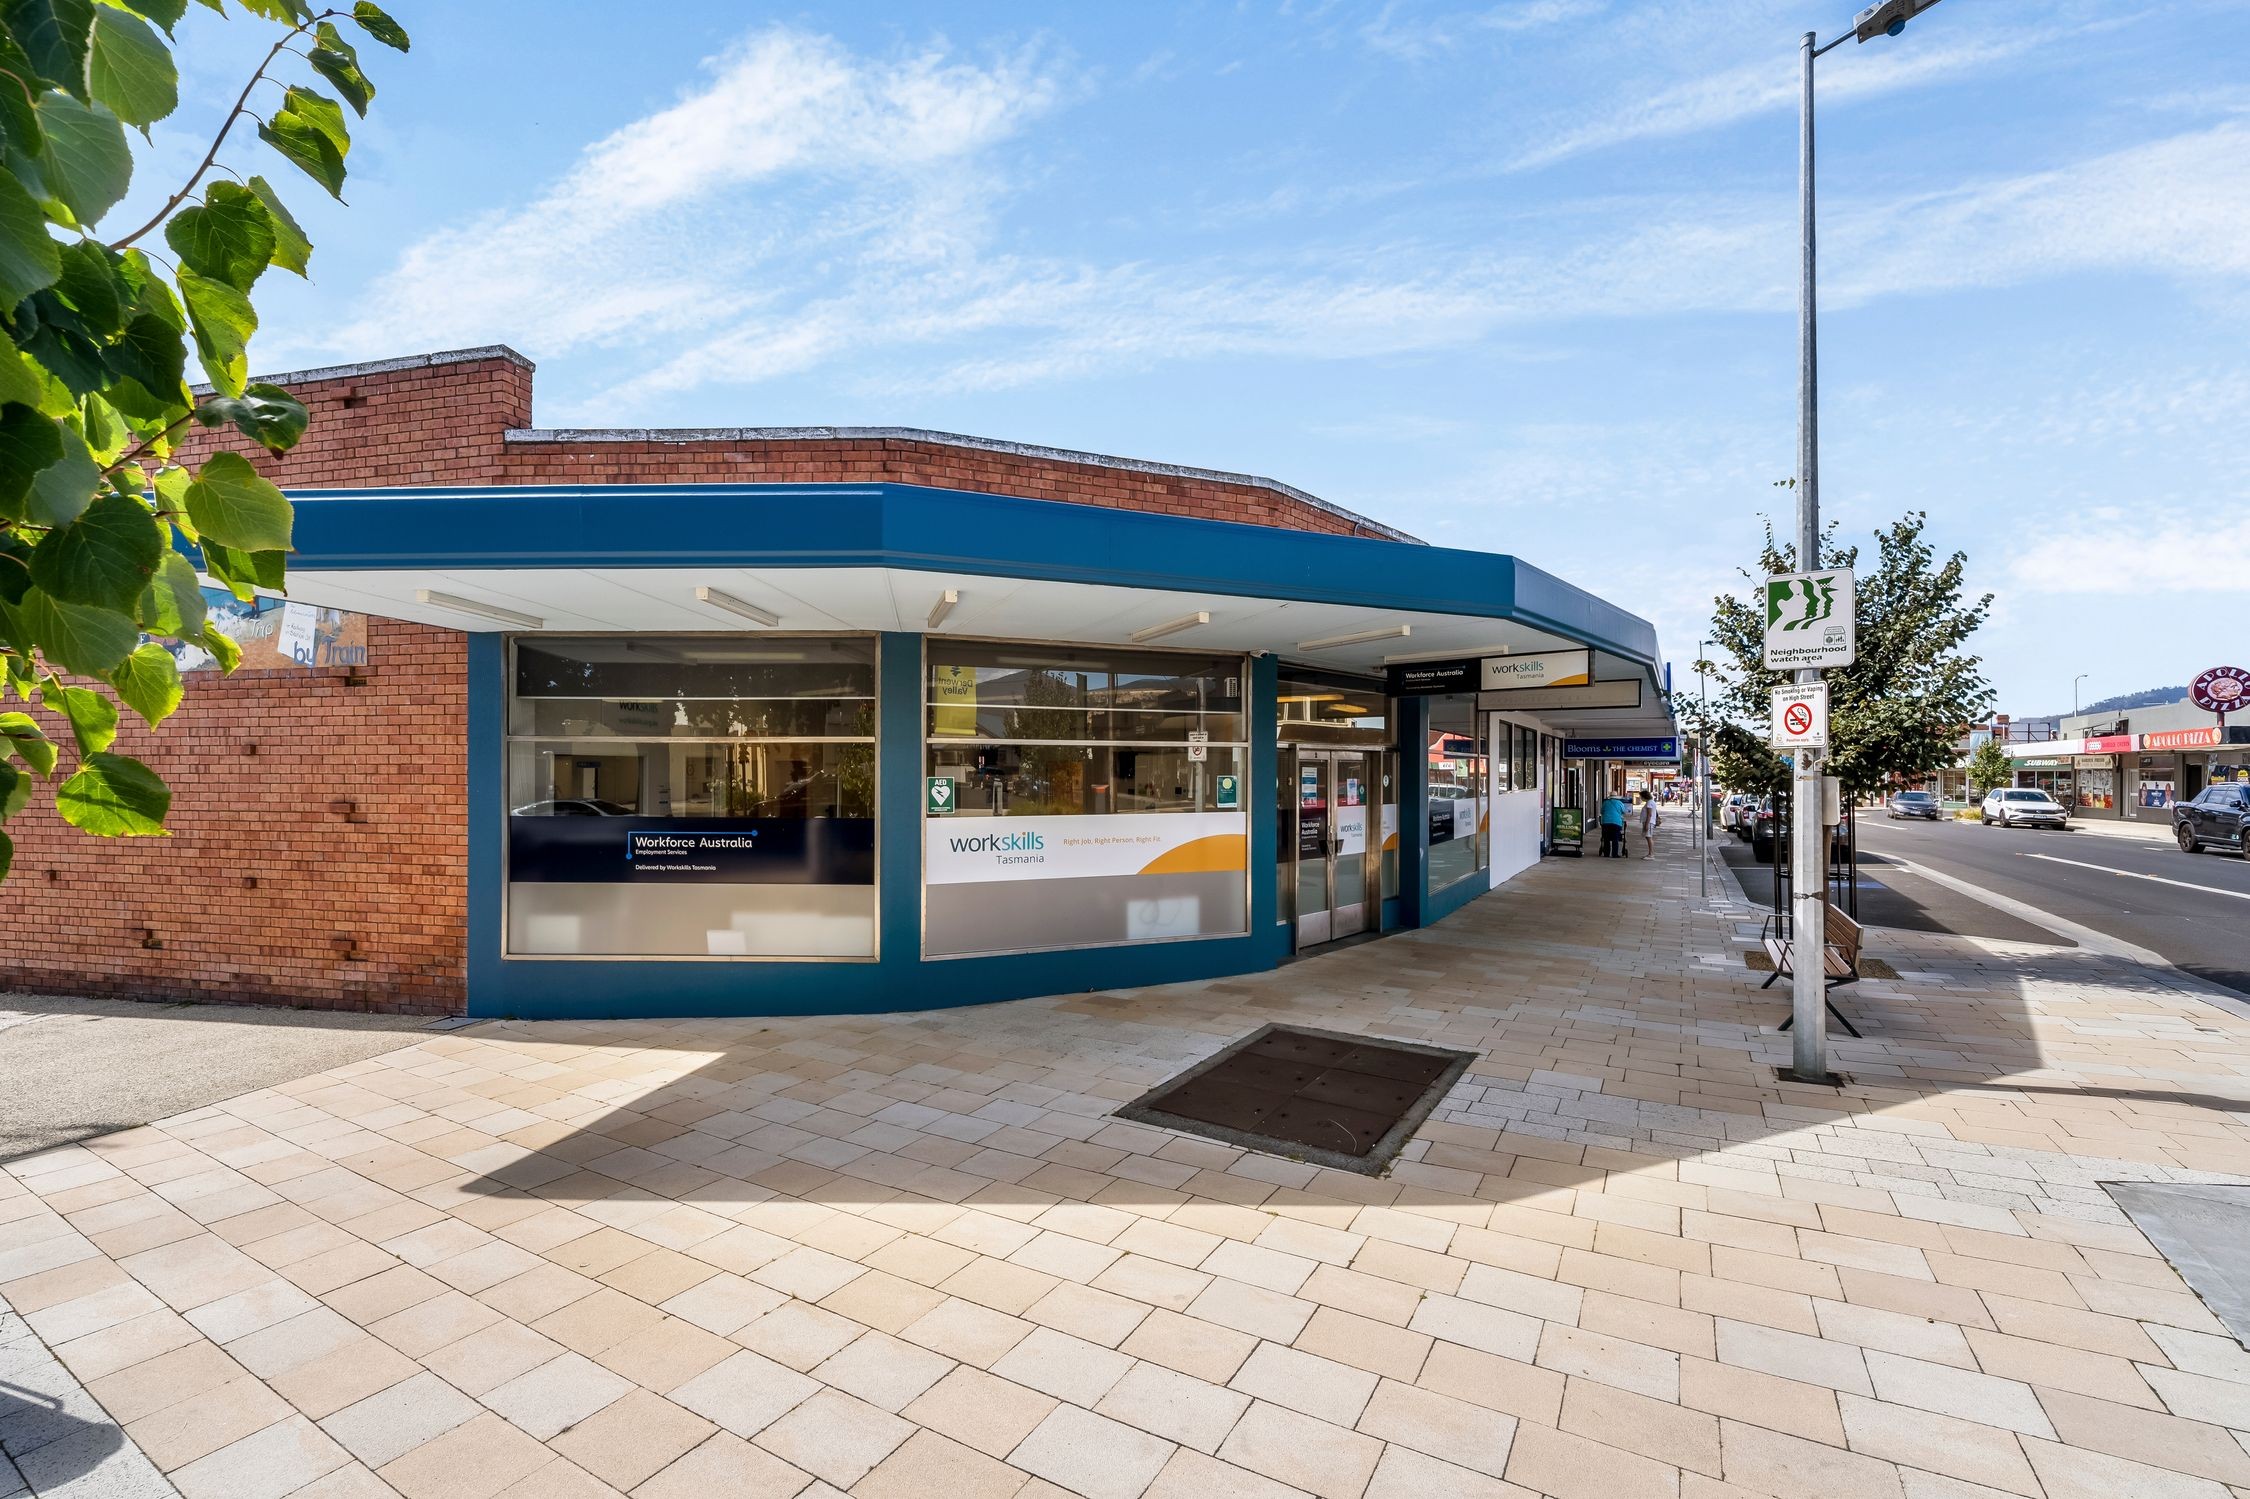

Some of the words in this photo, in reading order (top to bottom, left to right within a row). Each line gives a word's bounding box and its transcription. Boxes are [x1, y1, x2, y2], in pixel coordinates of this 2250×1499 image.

[293, 641, 316, 667] by
[322, 635, 366, 665] Train
[1770, 645, 1847, 656] Neighbourhood
[1770, 655, 1800, 663] watch
[1492, 661, 1545, 674] workskills
[1405, 671, 1435, 679] Workforce
[1436, 669, 1464, 677] Australia
[1516, 672, 1545, 680] Tasmania
[2151, 733, 2183, 747] APOLLO
[2184, 731, 2211, 745] PIZZA
[1567, 744, 1601, 753] Blooms
[1340, 823, 1363, 833] workskills
[635, 836, 696, 848] Workforce
[699, 836, 753, 848] Australia
[950, 831, 1044, 853] workskills
[1063, 838, 1080, 846] Right
[1081, 837, 1093, 846] Job,
[1094, 837, 1111, 845] Right
[1136, 836, 1152, 844] Right
[996, 854, 1045, 865] Tasmania
[659, 864, 666, 872] by
